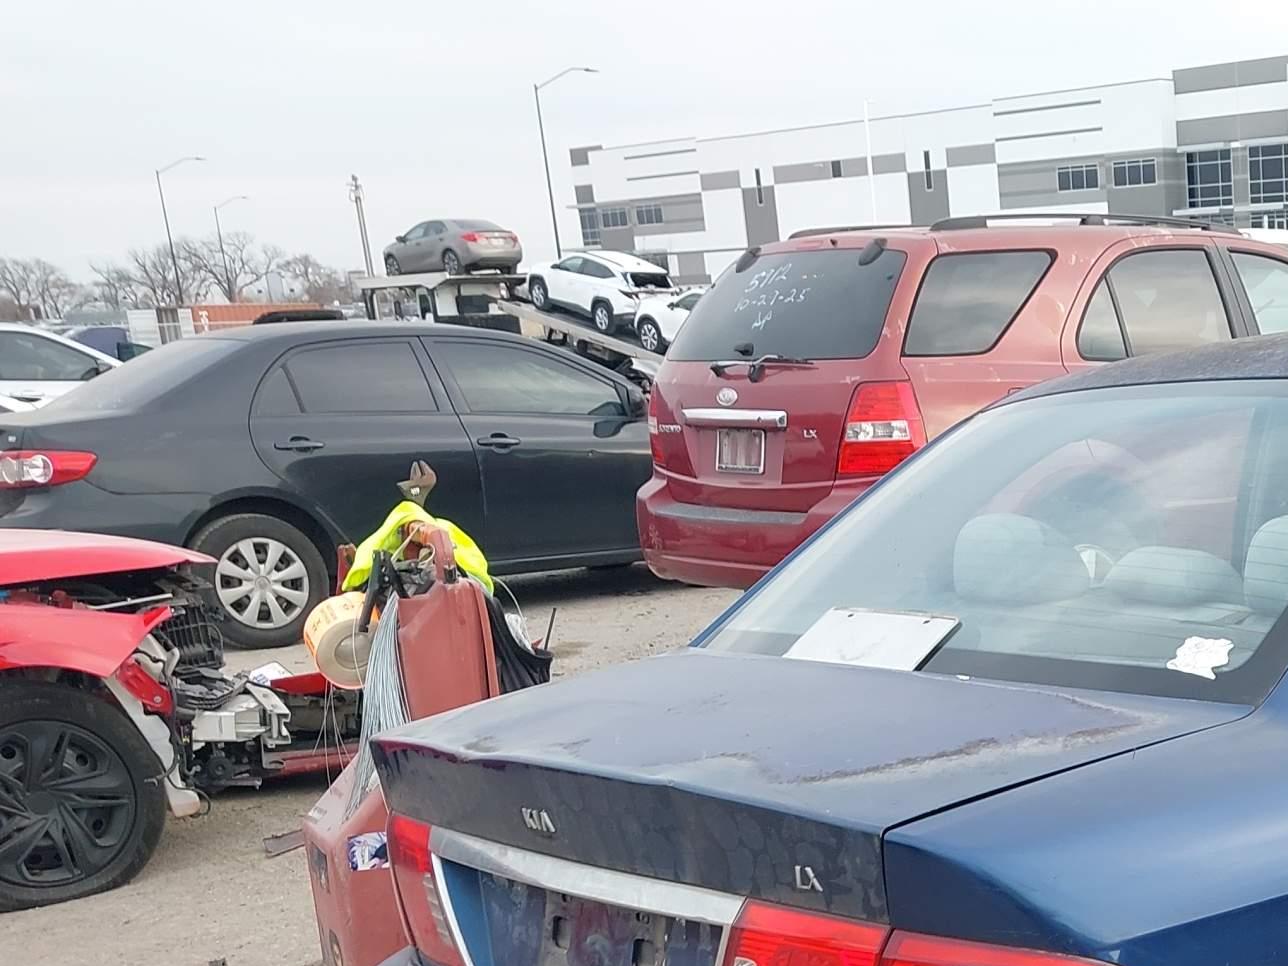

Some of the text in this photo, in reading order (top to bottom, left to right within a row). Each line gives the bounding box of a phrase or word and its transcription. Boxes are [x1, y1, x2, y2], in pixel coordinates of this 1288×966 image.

[803, 429, 817, 438] LX
[521, 807, 557, 833] KIA
[794, 865, 824, 892] LX
